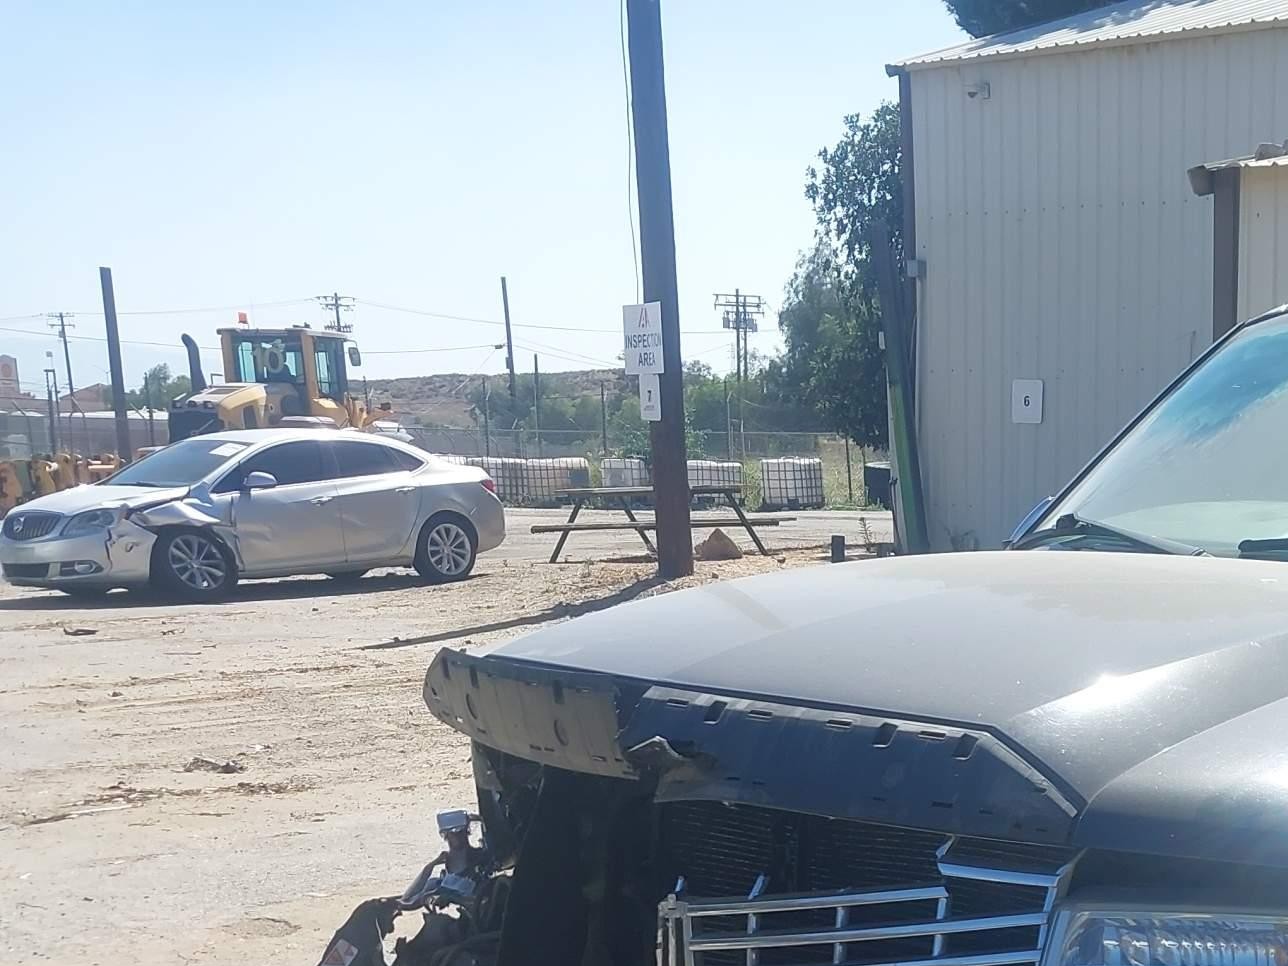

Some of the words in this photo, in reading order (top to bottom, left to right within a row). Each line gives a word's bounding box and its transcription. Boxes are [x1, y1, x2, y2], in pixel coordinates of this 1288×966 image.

[638, 352, 656, 367] AREA
[647, 390, 652, 403] 7
[1023, 395, 1030, 407] 6
